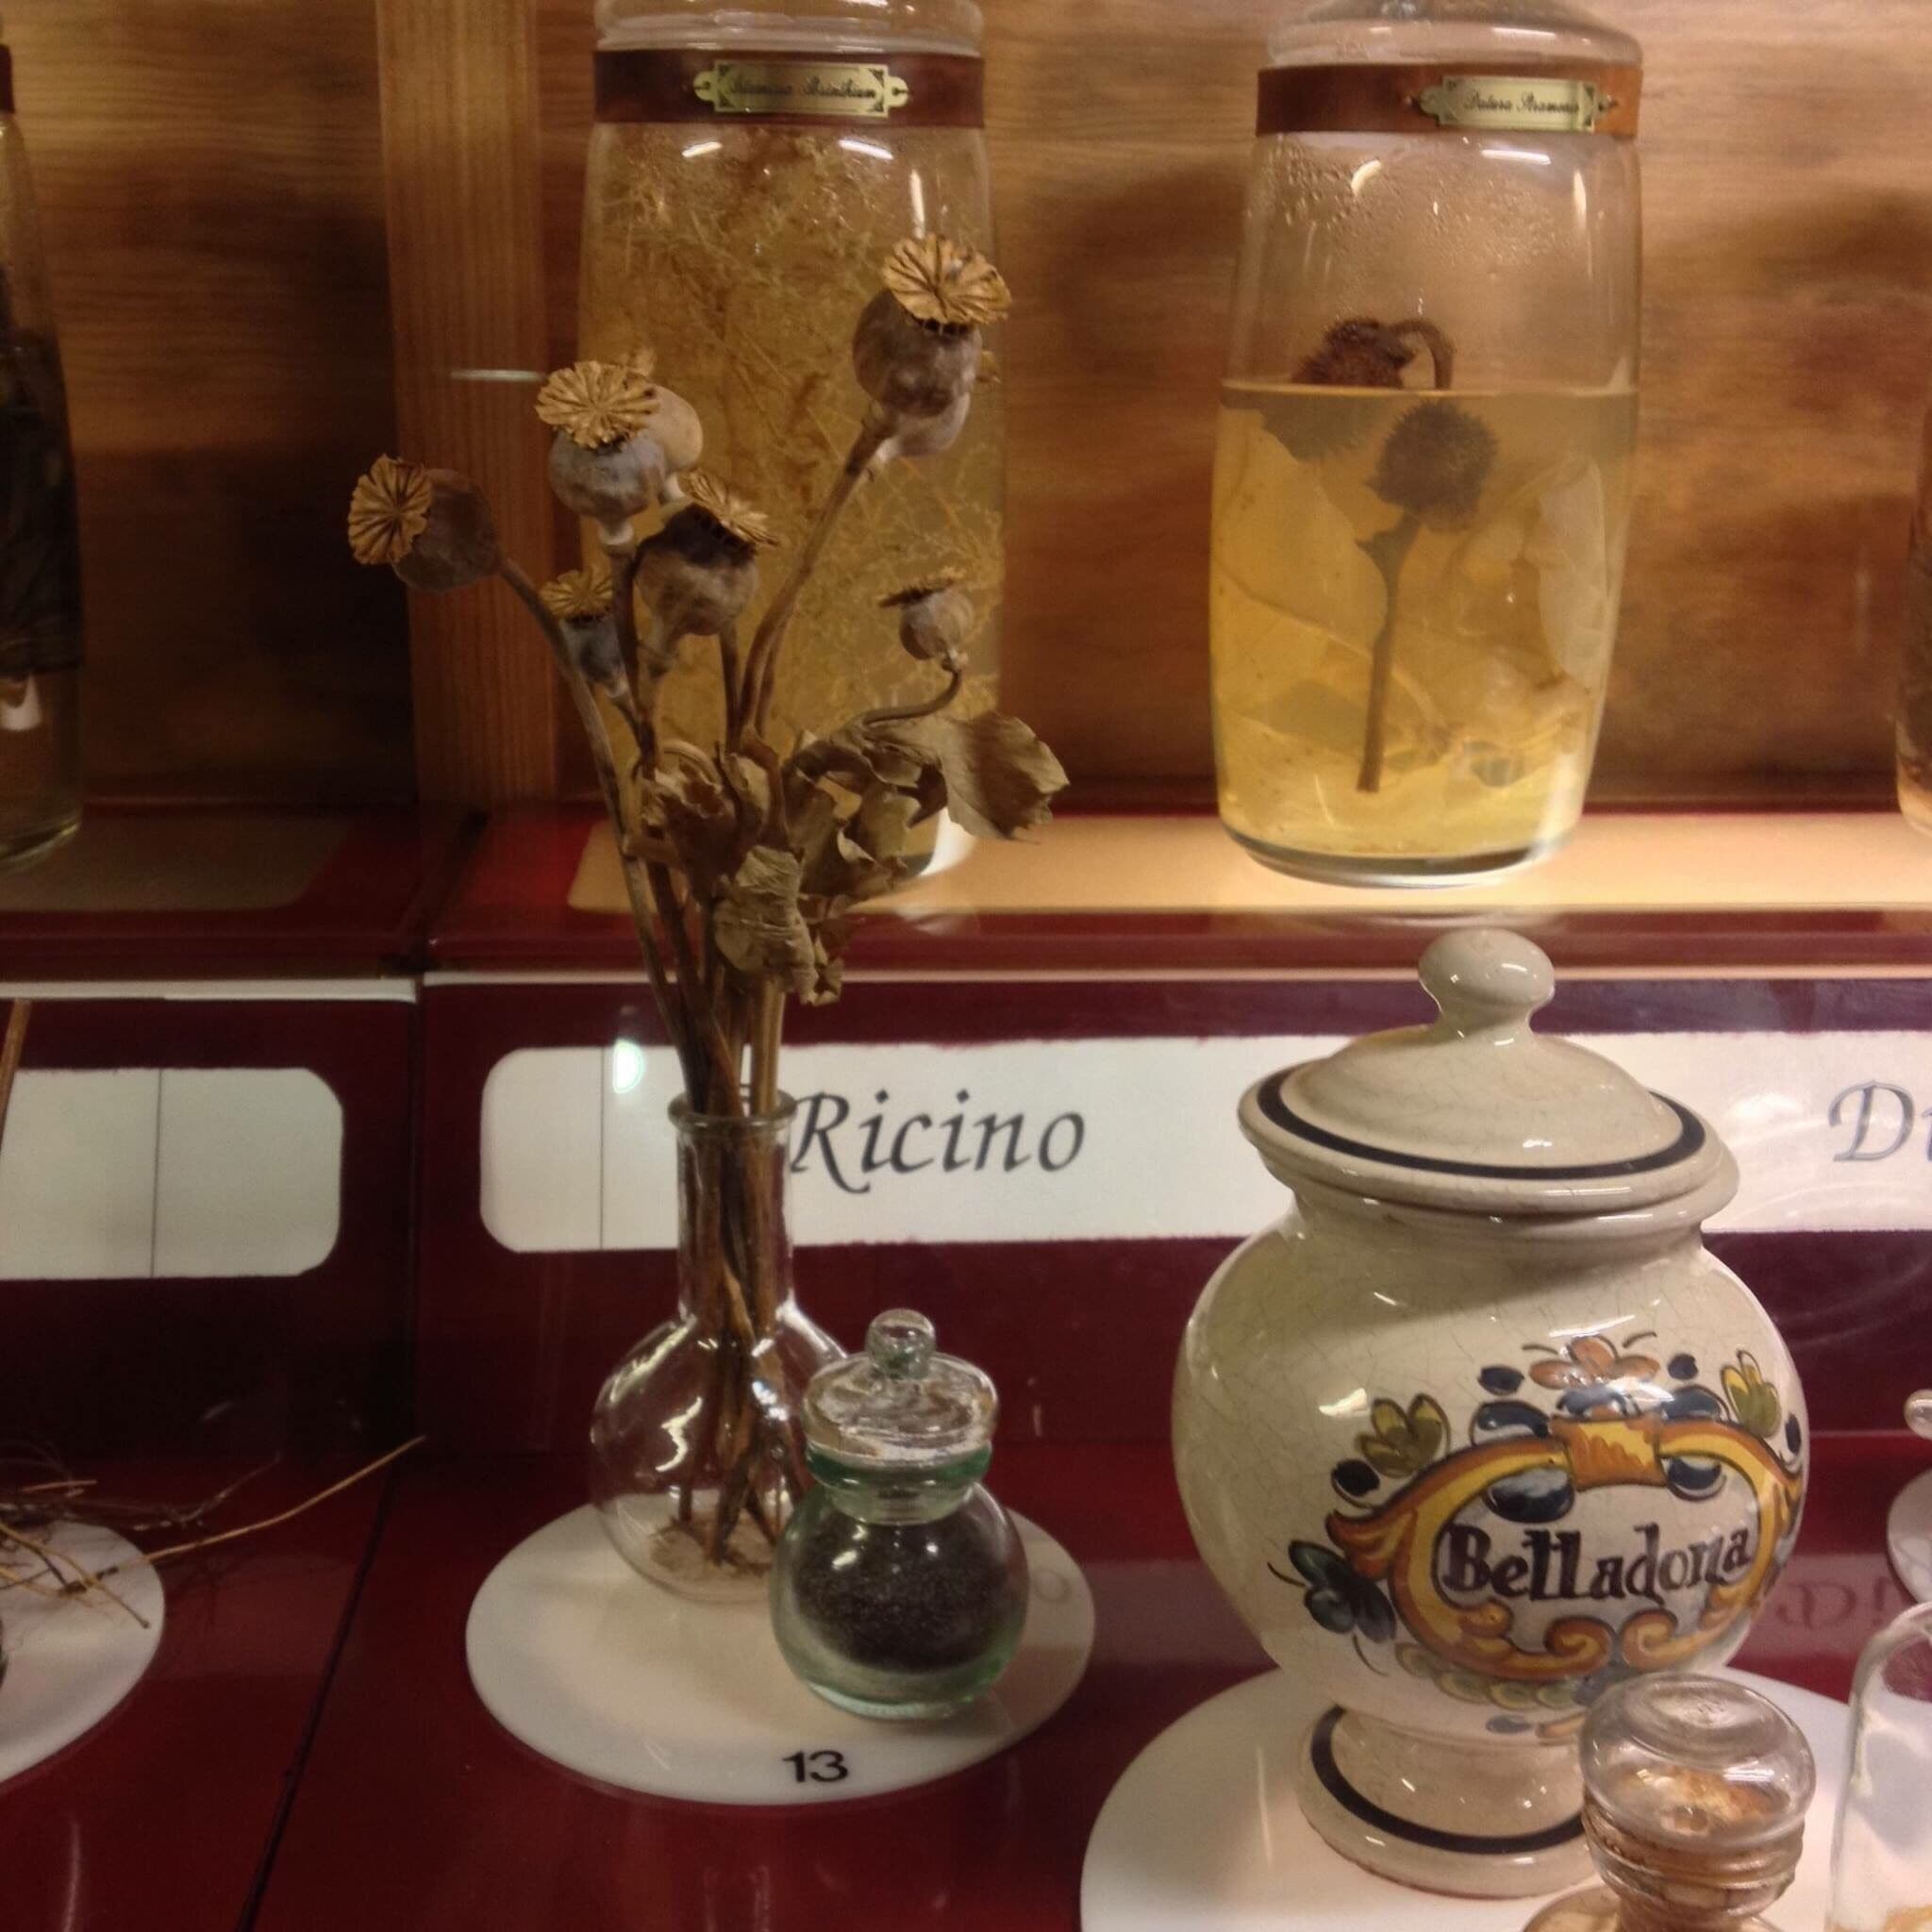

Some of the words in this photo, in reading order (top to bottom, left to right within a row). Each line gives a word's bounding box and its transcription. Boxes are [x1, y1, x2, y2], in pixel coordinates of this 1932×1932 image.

[790, 1089, 1085, 1194] Ricino
[1442, 1522, 1751, 1606] Belladona
[782, 1749, 848, 1783] 13
